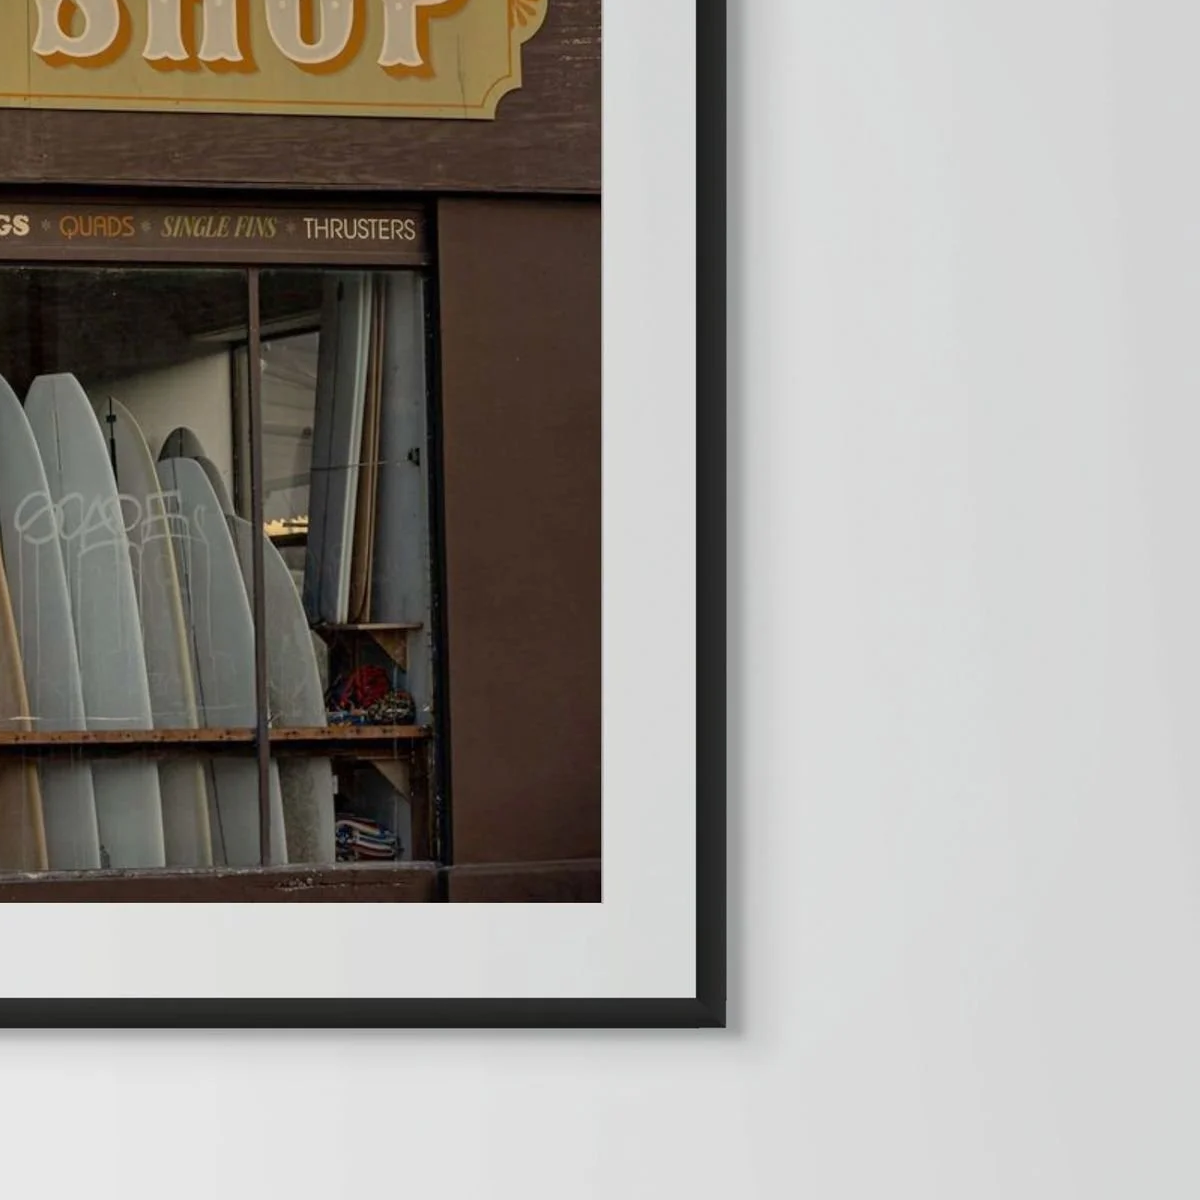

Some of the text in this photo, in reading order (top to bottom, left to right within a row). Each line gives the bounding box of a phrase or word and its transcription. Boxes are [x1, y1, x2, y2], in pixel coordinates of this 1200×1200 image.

[59, 215, 135, 240] QUADS
[161, 215, 231, 238] SINGLE
[234, 216, 277, 238] FINS
[303, 217, 417, 241] THRUSTERS
